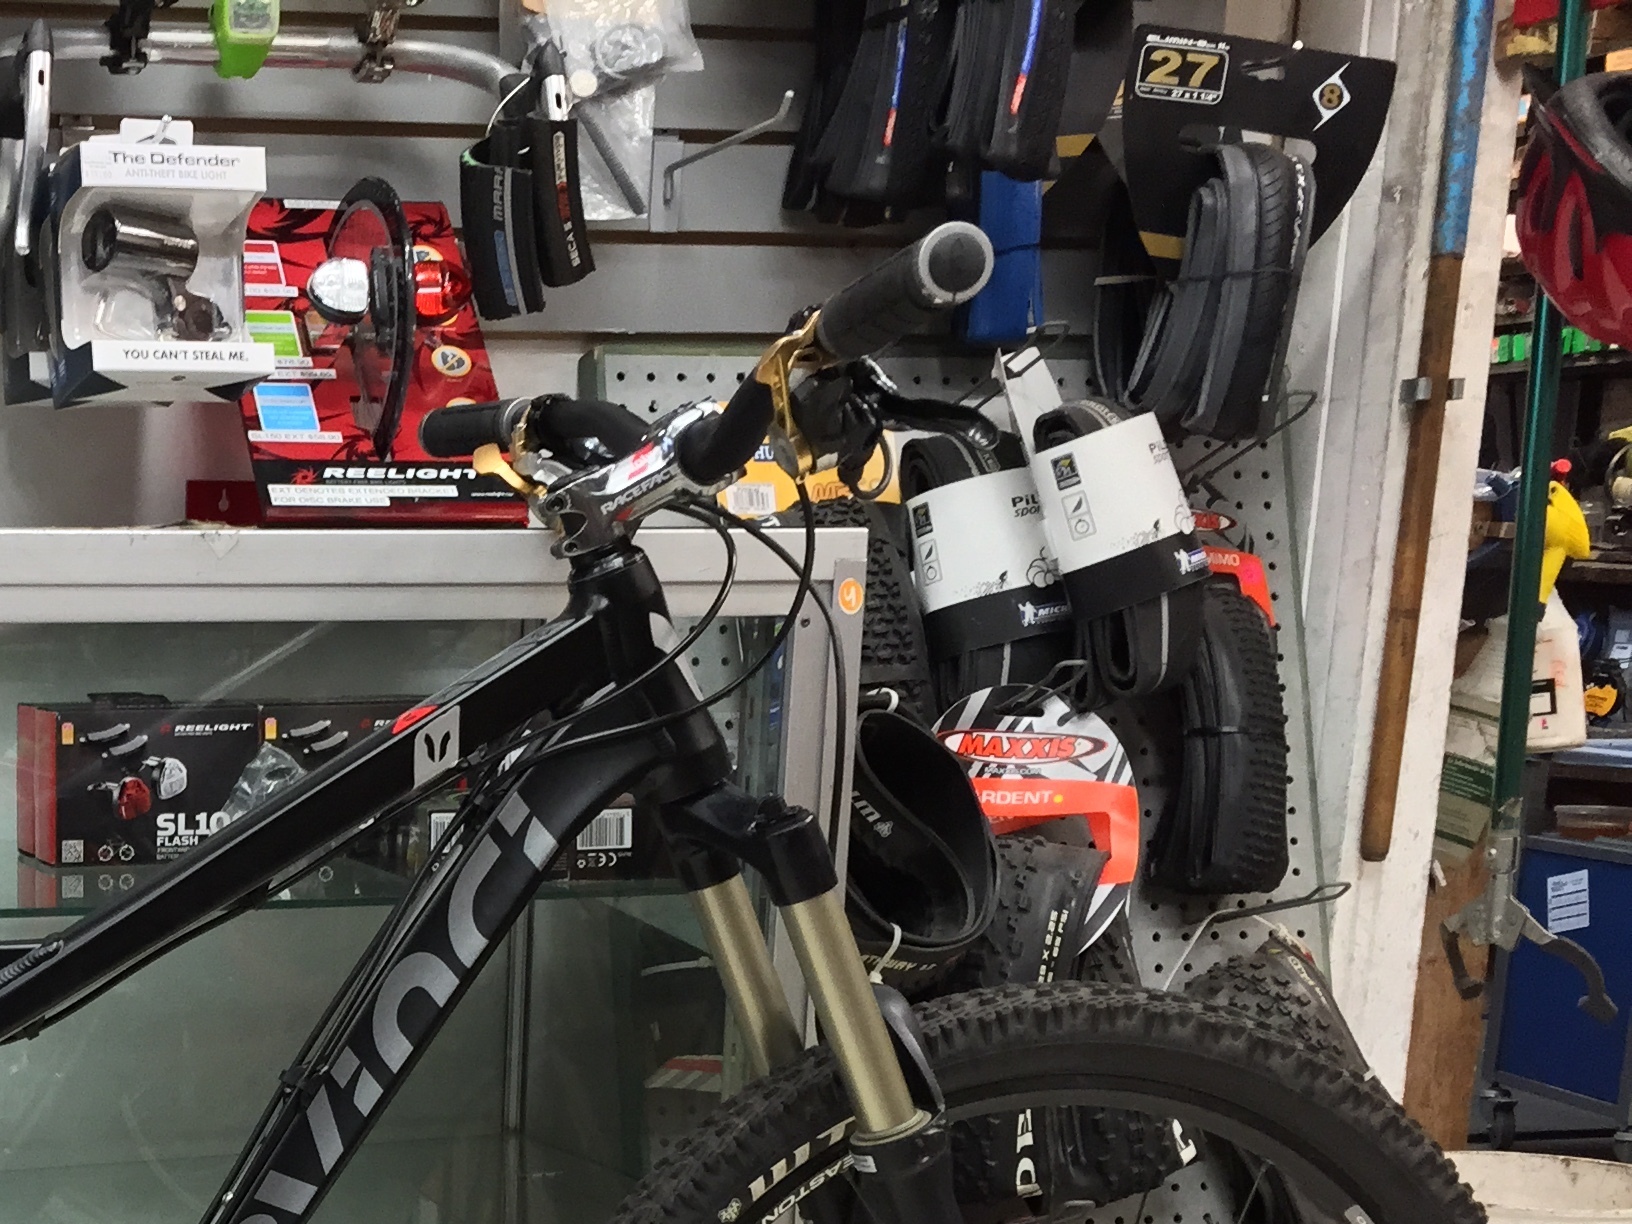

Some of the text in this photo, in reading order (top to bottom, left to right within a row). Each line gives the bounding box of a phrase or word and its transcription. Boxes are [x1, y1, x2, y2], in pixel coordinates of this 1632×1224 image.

[1145, 48, 1220, 88] 27
[1170, 88, 1183, 98] 27
[110, 151, 241, 167] The Defender
[124, 168, 227, 180] ANTI-THEFT BIKE LIGHT
[122, 348, 250, 363] YOU CAN'T STEAL ME.
[322, 466, 477, 480] REELIGHT
[270, 487, 456, 495] EXT DENOTES EXTENDED BRACKET
[599, 468, 674, 516] RACEFAC
[273, 496, 387, 504] FOR DISC BRAKE USE
[174, 722, 253, 733] REELIGHT
[958, 732, 1076, 759] MAXXIS
[980, 790, 1053, 805] RDENT
[156, 836, 200, 846] FLASH
